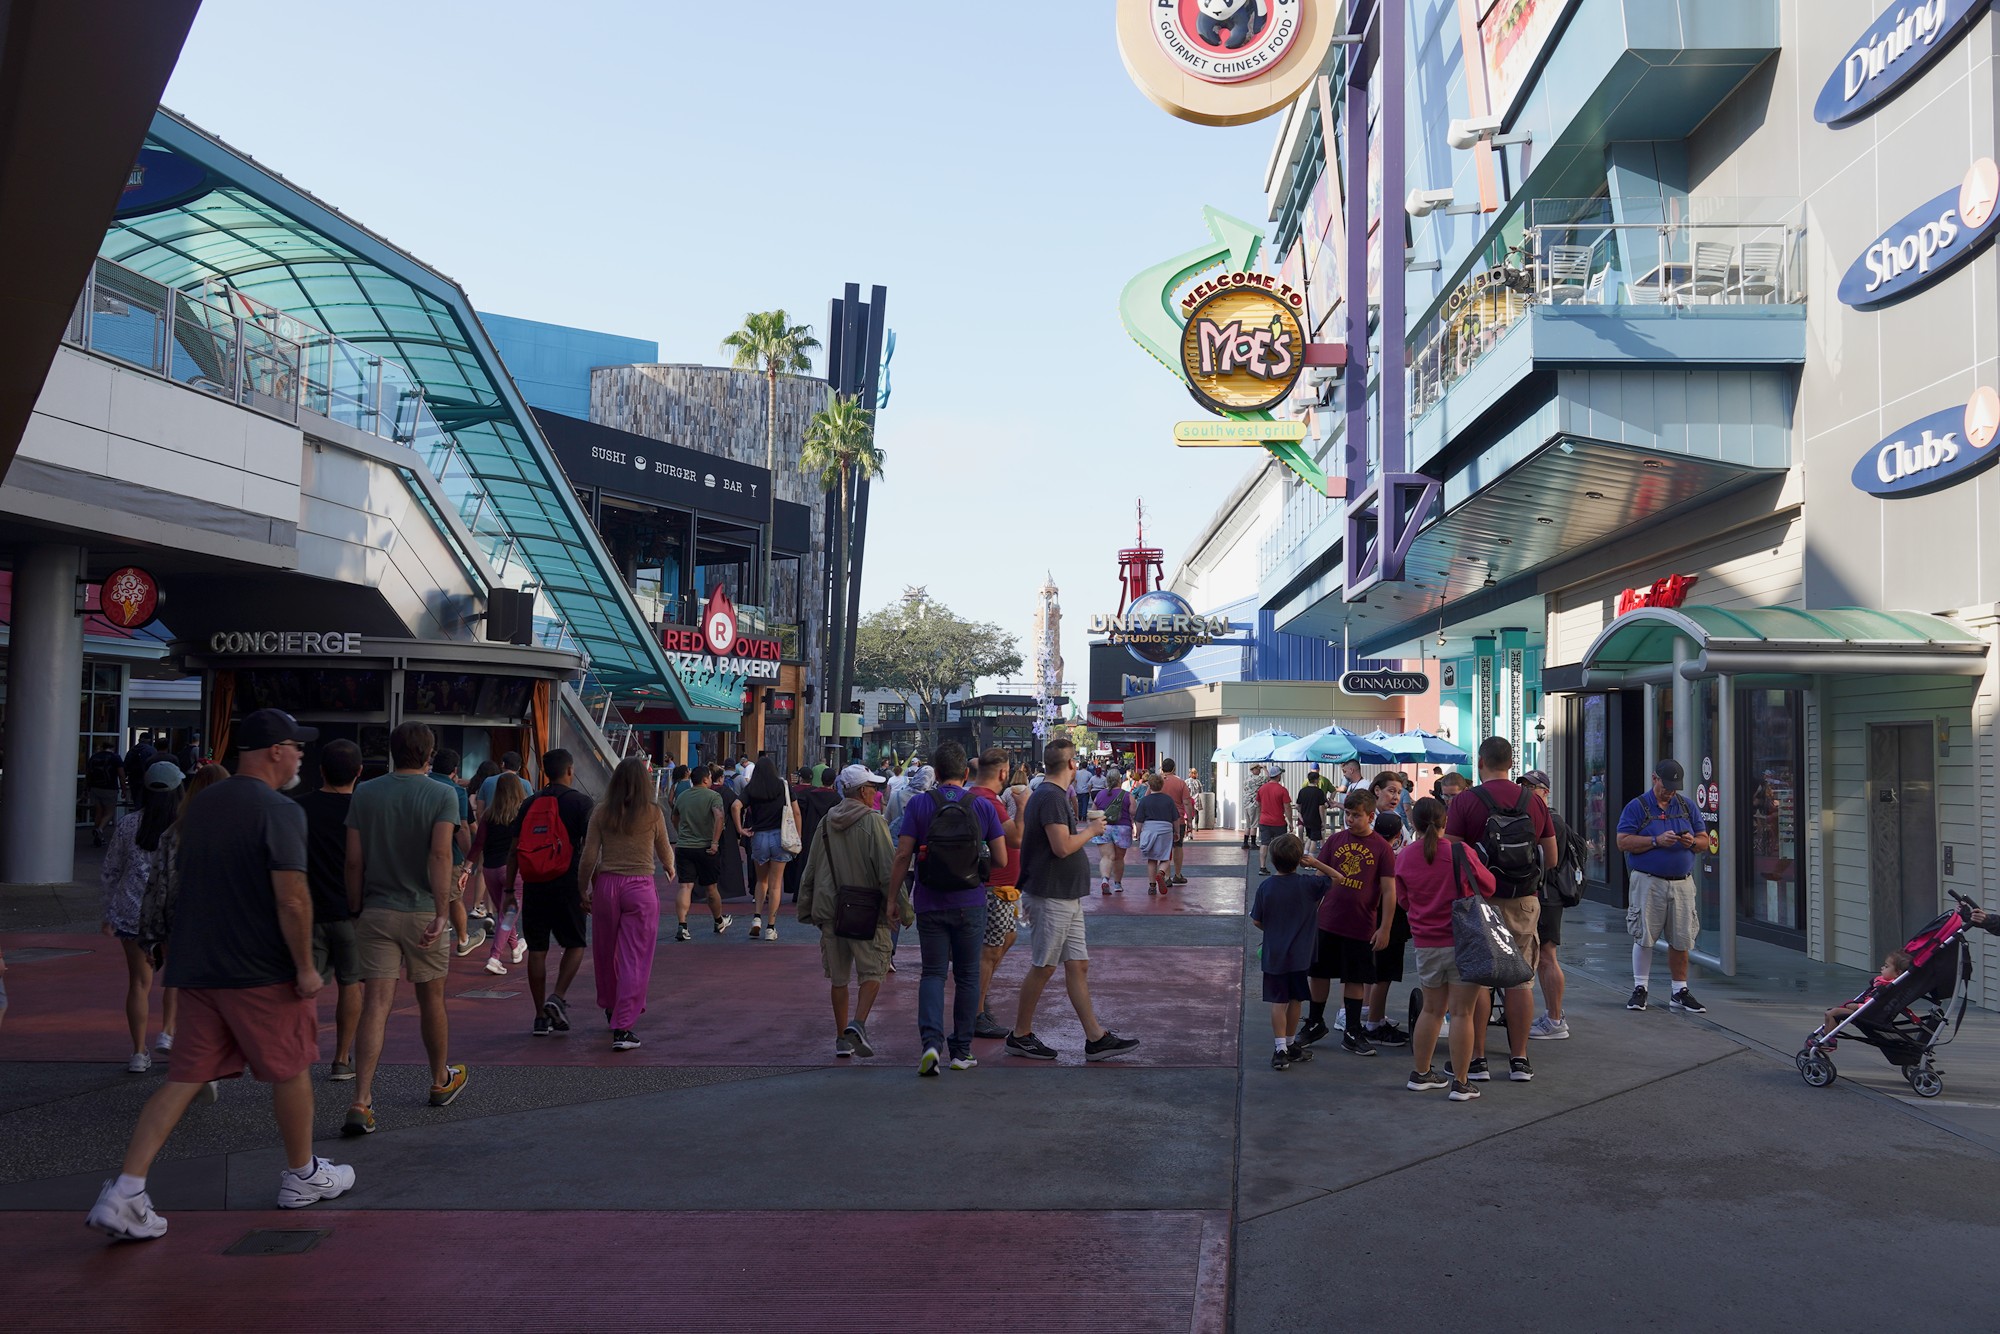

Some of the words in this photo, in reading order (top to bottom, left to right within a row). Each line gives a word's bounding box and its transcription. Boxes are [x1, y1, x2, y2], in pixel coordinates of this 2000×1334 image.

[1160, 21, 1209, 70] GOURMET
[1213, 51, 1268, 73] CHINESE
[1268, 18, 1293, 53] FOOD
[1844, 0, 1946, 102] Dining
[1865, 208, 1958, 292] Shops
[1181, 272, 1276, 309] WELCOME
[1279, 283, 1303, 307] TO
[1183, 424, 1259, 437] southwest
[1264, 424, 1296, 438] grill
[1877, 430, 1959, 484] Clubs
[591, 446, 627, 465] SUSHI
[655, 461, 697, 483] BURGER
[723, 478, 743, 493] BAR
[715, 621, 727, 642] R
[1090, 613, 1236, 636] UNIVERSAL
[211, 631, 362, 655] CONCIERGE
[664, 629, 704, 652] RED
[735, 637, 780, 660] OVEN
[1114, 634, 1170, 643] STUDIOS
[1173, 634, 1214, 645] STORE
[717, 656, 781, 679] BAKERY
[1348, 675, 1424, 690] CINNABON
[1700, 812, 1718, 823] PSTAIRS
[1333, 842, 1375, 866] HOGWARTS
